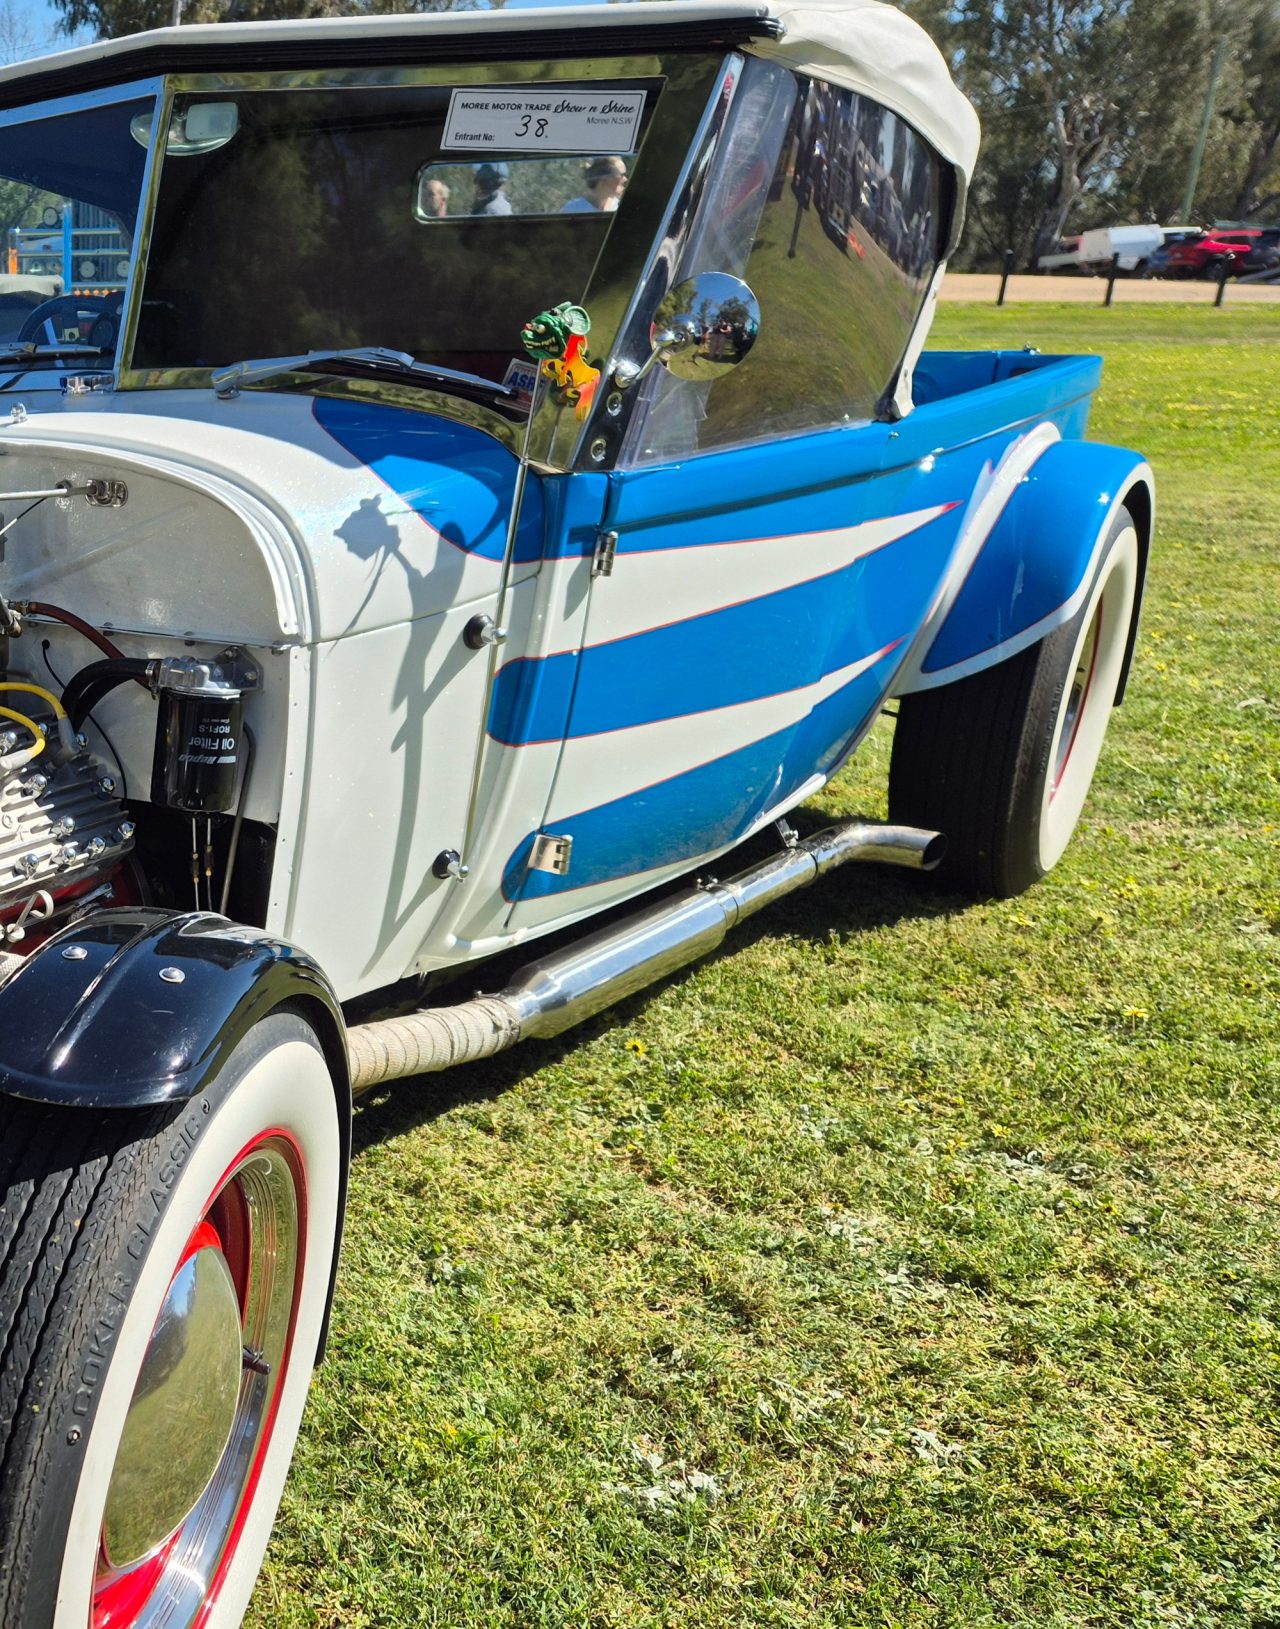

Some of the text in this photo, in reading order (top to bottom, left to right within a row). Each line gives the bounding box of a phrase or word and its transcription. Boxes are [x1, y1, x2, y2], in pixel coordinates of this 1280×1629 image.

[461, 99, 635, 114] MOREE MOTOR TRADE Show n Shine
[586, 116, 609, 125] Moree
[454, 132, 495, 142] Entrant No:
[188, 737, 235, 750] Oil Filter
[72, 1115, 201, 1416] COKER CLASSIC
